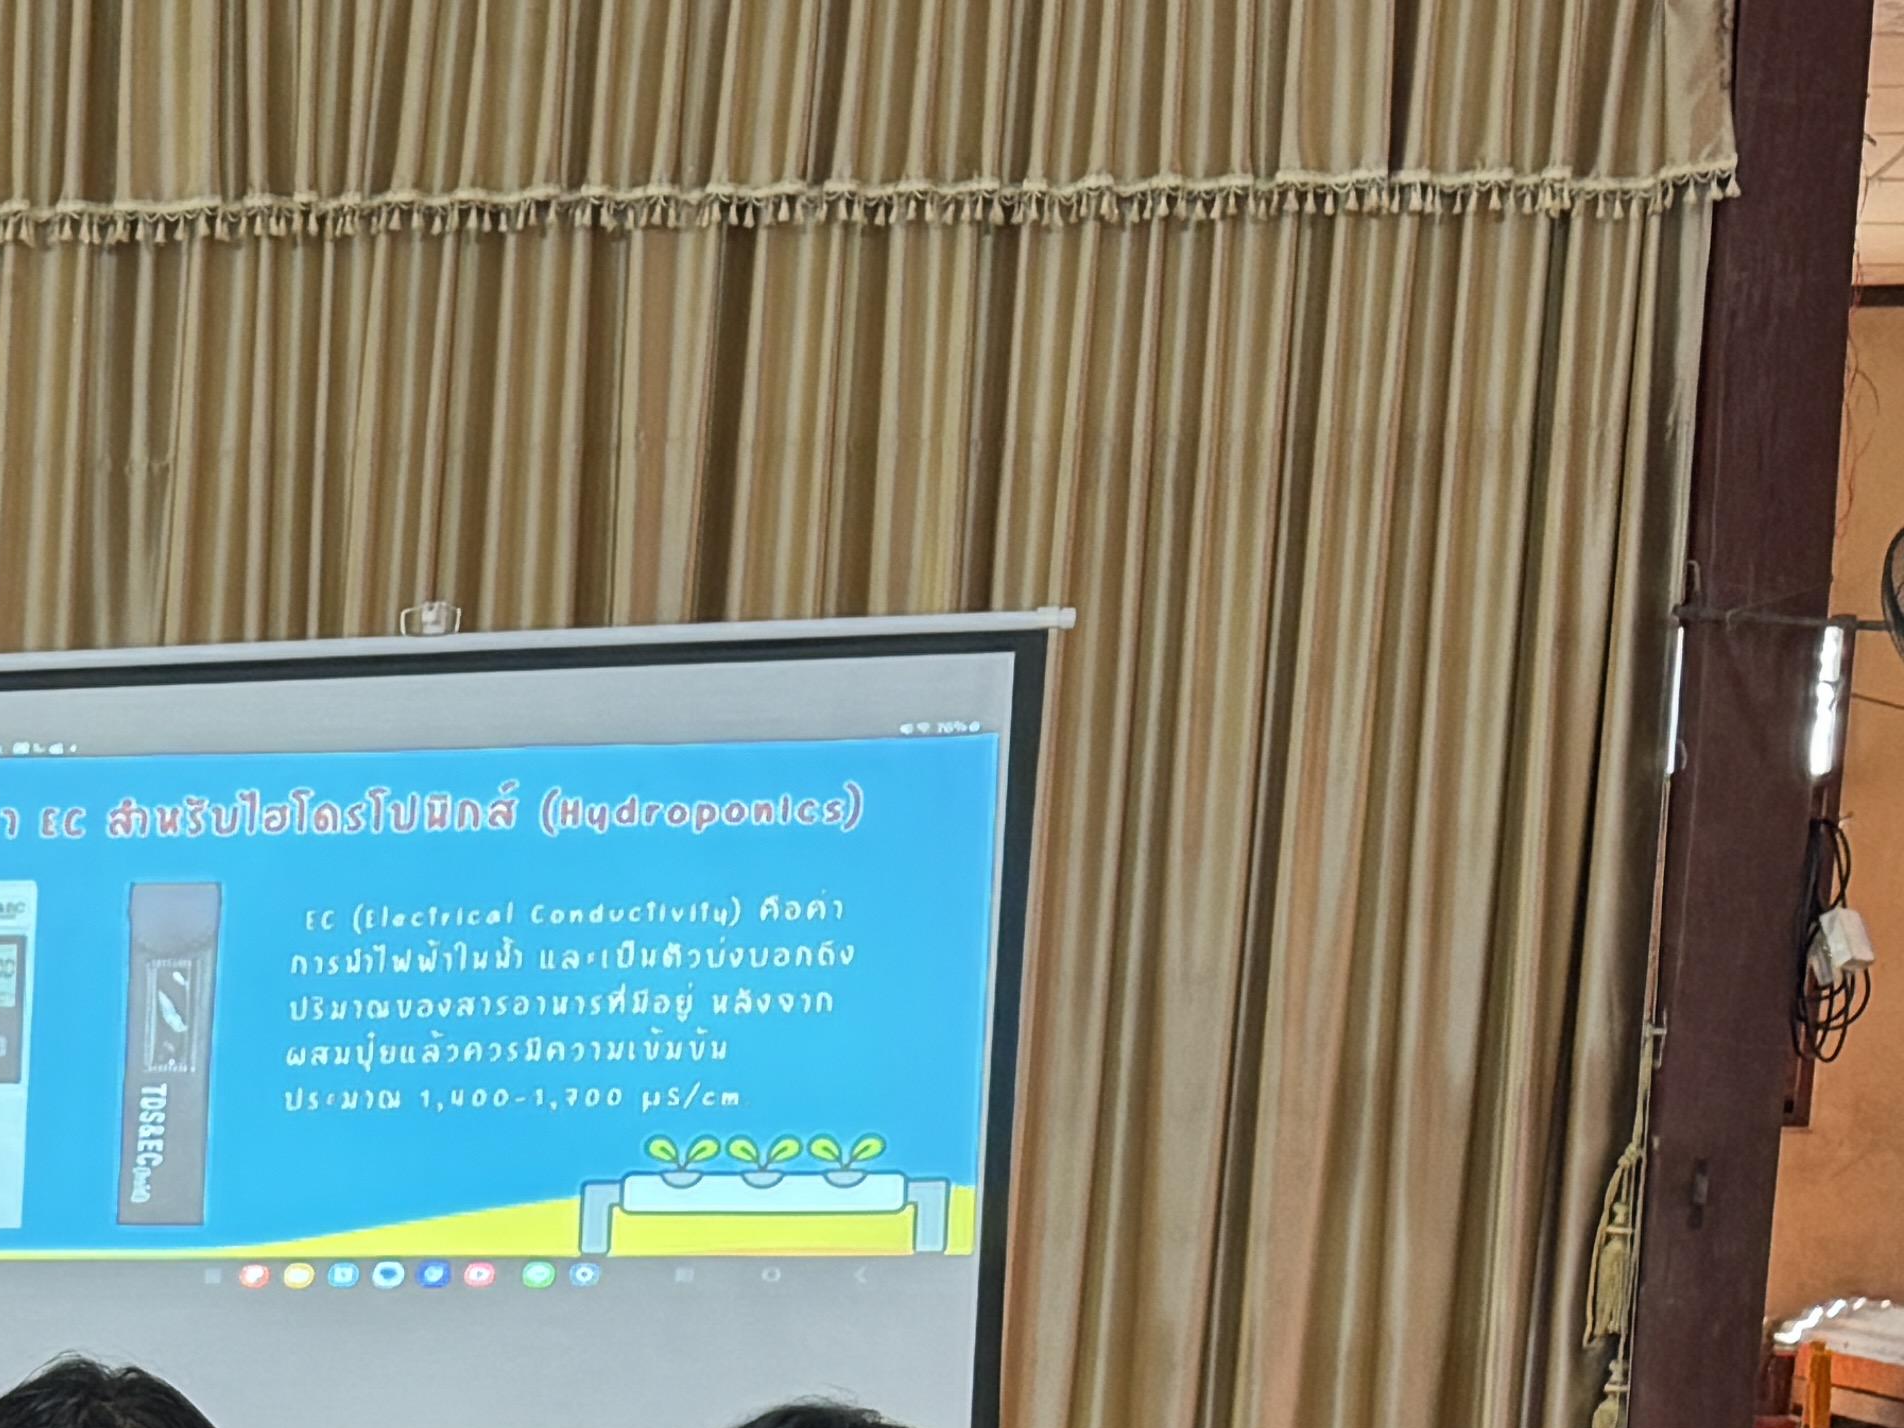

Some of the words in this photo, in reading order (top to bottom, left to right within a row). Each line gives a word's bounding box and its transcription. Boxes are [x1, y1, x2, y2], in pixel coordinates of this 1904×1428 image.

[39, 806, 87, 840] EC
[540, 780, 863, 838] (Hydroponics)
[306, 910, 335, 930] EC
[353, 901, 514, 935] (Electrical
[531, 896, 741, 927] Conductivity)
[713, 987, 833, 1015] หลังจาก
[284, 1087, 401, 1112] ประมาณ
